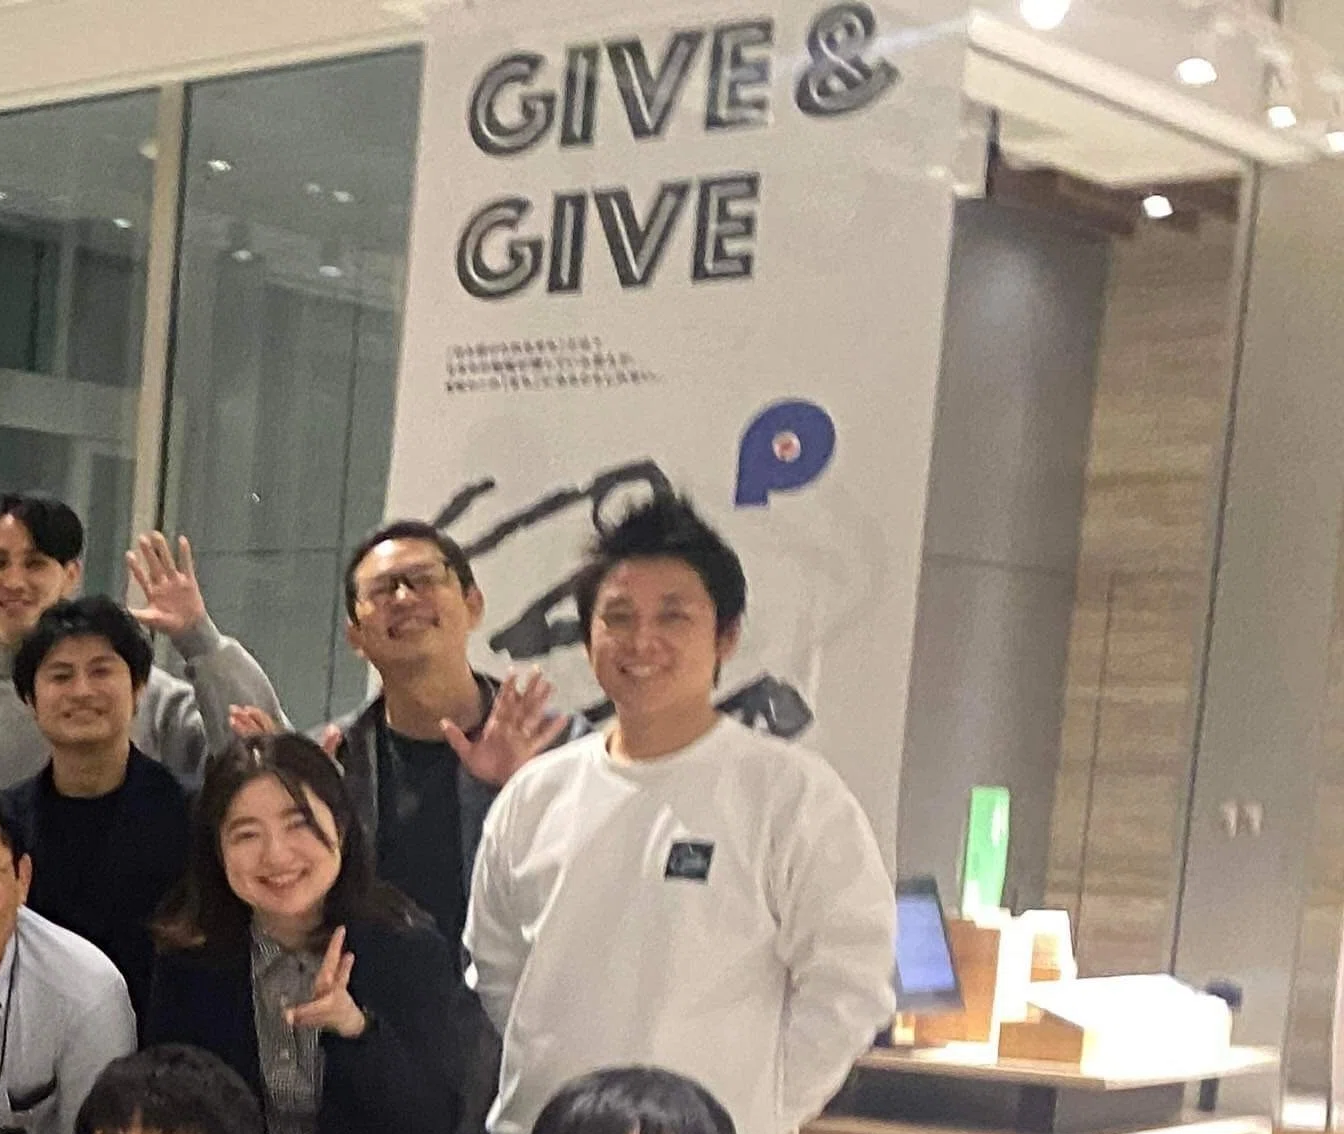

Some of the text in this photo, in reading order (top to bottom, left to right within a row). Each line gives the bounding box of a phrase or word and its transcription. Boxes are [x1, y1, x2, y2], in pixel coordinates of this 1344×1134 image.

[469, 1, 900, 157] GIVE &
[456, 173, 760, 301] GIVE
